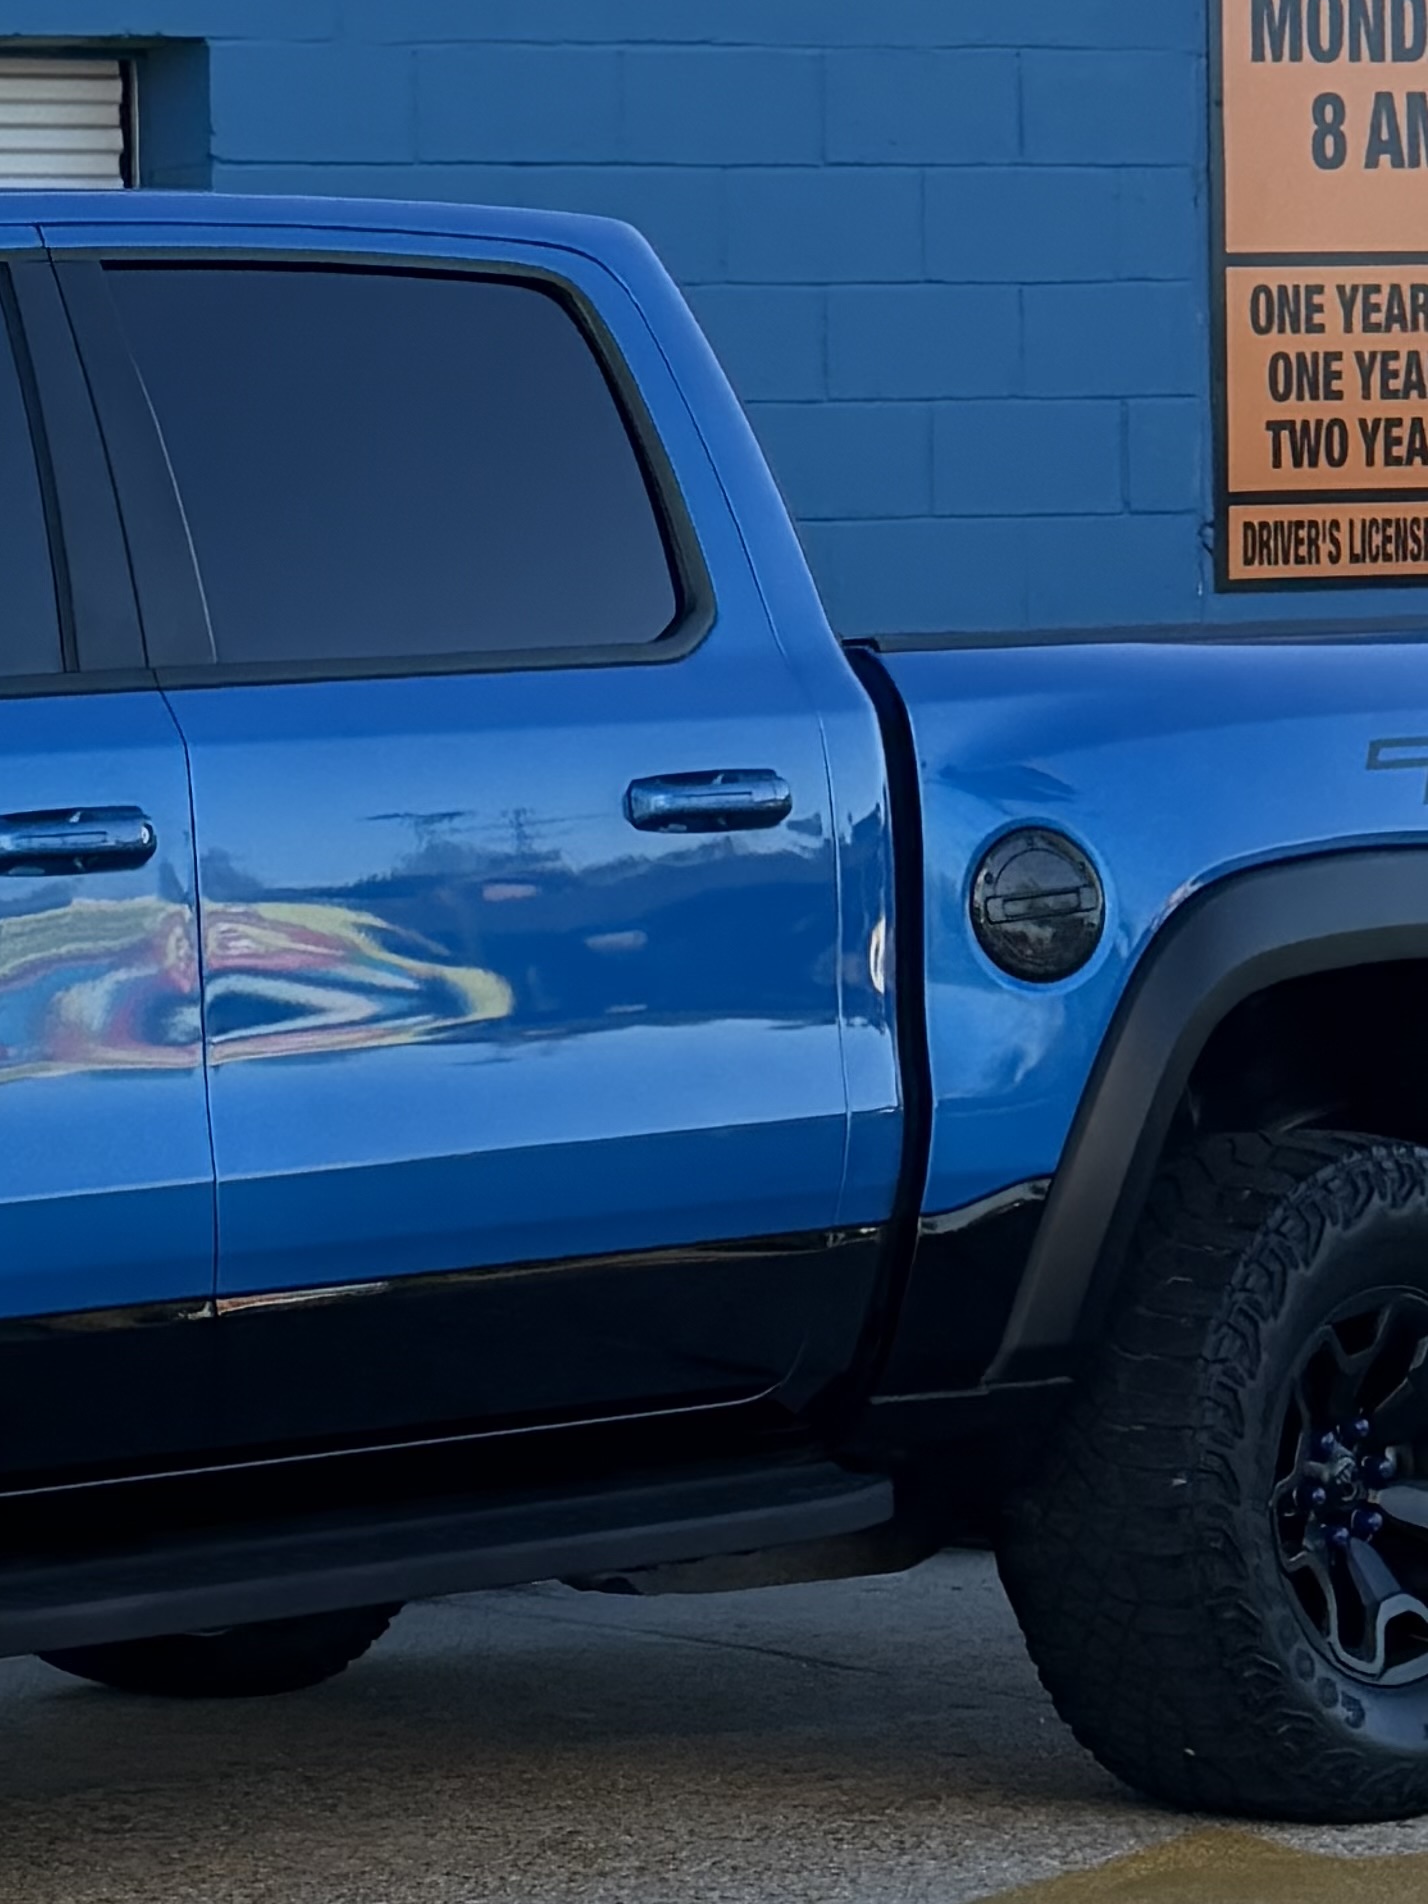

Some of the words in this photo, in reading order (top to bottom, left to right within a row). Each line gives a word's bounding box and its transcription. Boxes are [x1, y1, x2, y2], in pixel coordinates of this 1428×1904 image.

[1312, 92, 1347, 170] 8
[1250, 283, 1325, 336] ONE
[1269, 351, 1344, 402] ONE
[1265, 418, 1348, 469] TWO
[1243, 519, 1341, 566] DRIVER'S
